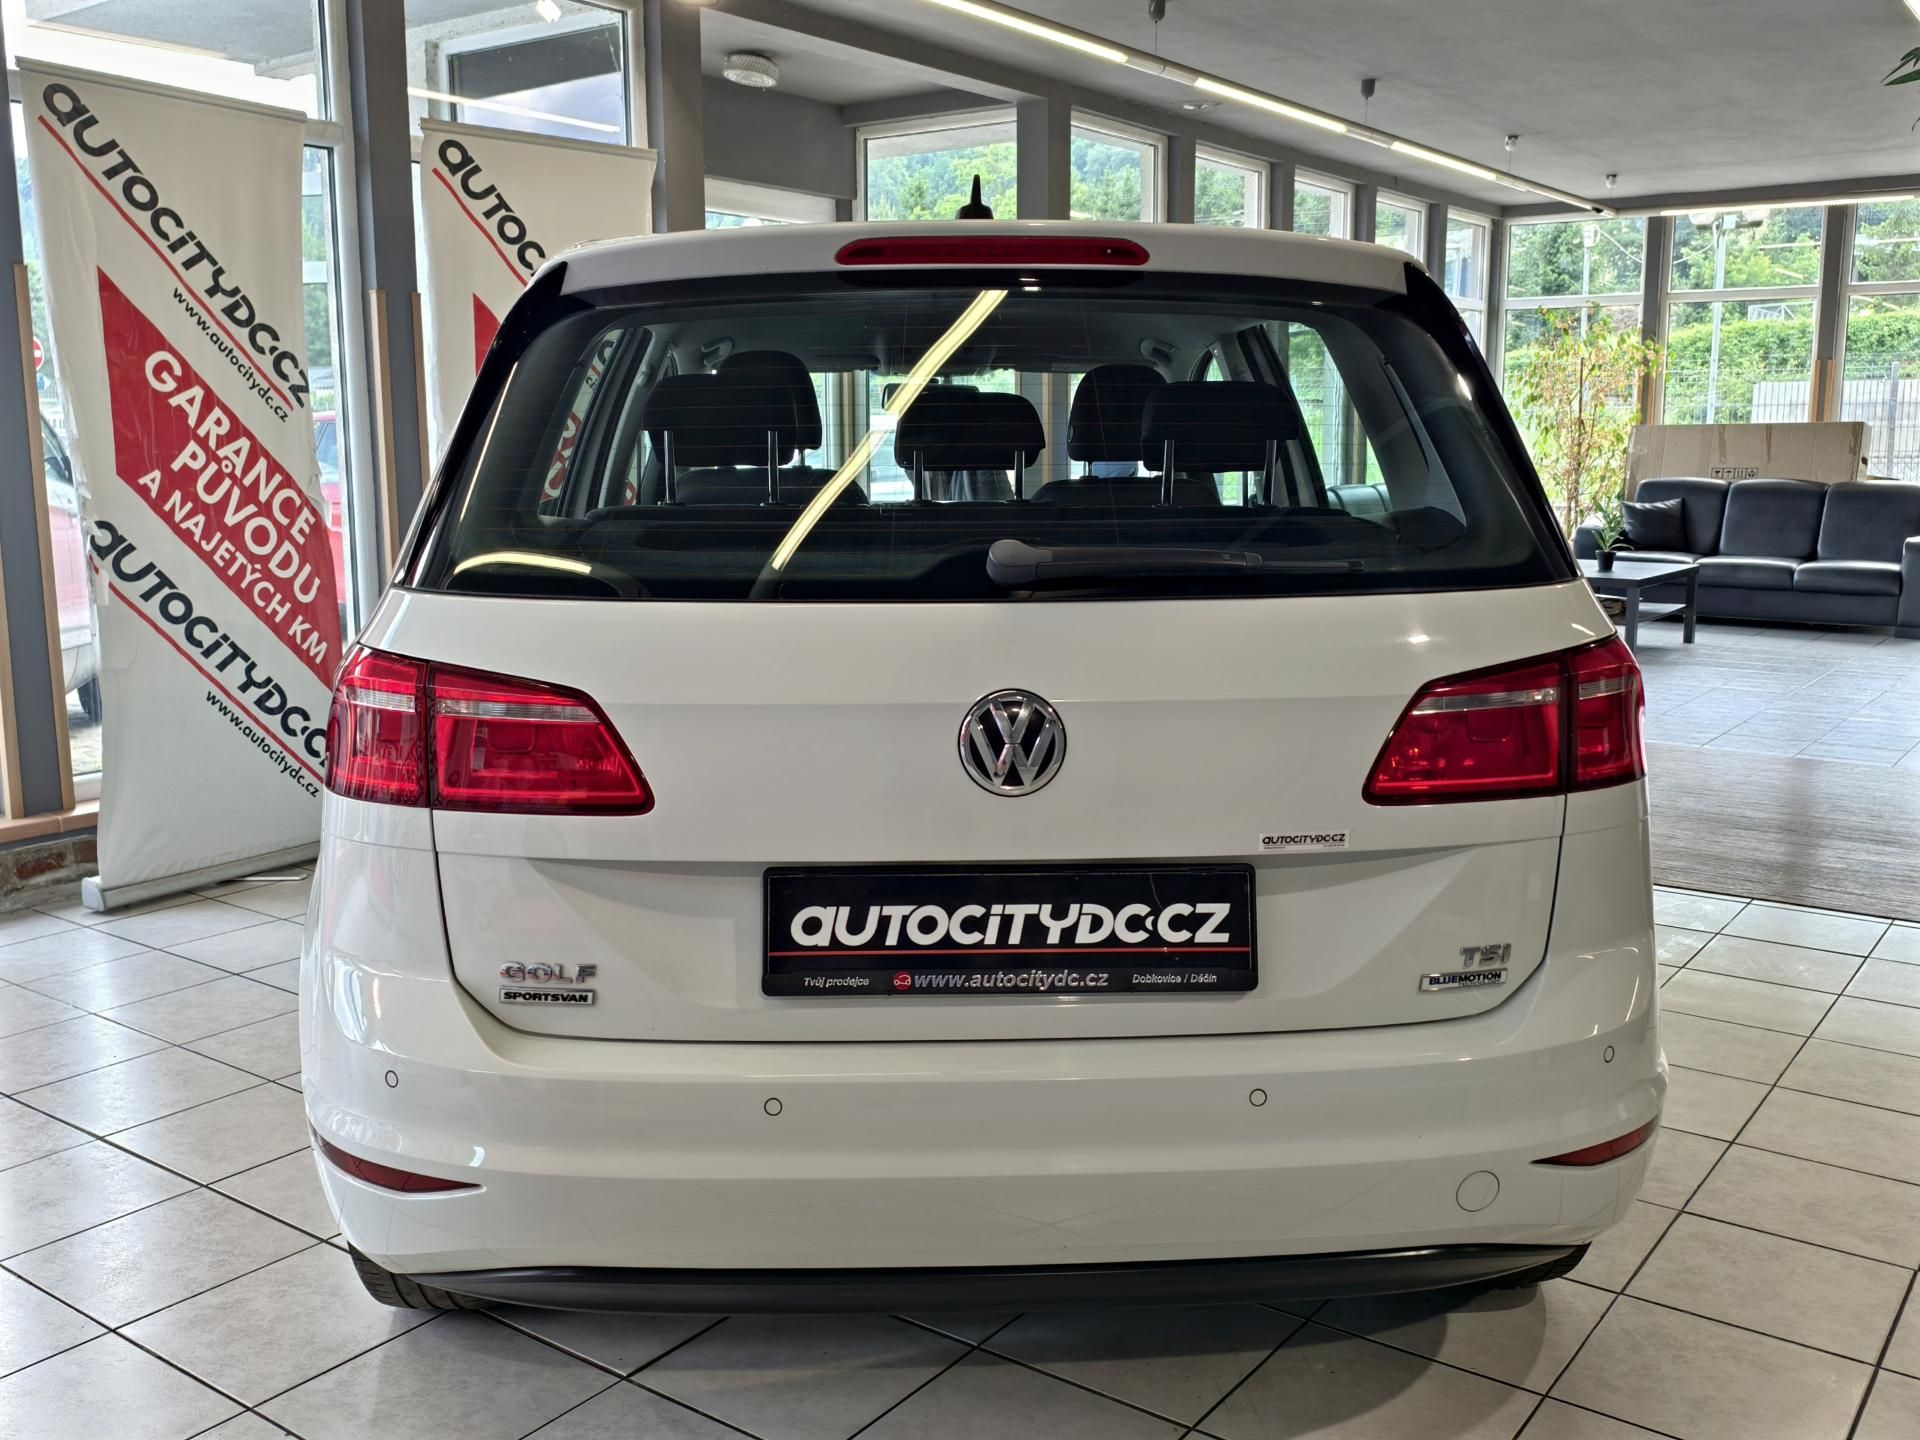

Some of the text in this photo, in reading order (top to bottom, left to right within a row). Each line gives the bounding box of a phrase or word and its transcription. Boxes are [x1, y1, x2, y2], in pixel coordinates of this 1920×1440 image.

[173, 287, 289, 423] www.autocitydc.cz
[144, 350, 316, 546] GARANCE
[170, 440, 321, 604] PŮVODU
[138, 469, 328, 665] A NAJETÝCH KM
[205, 690, 320, 798] www.autocitydc.cz
[1460, 943, 1512, 968] TSI
[499, 961, 597, 985] GOLF
[825, 976, 870, 989] prodejce
[914, 969, 1110, 991] www.autocitydc.cz
[1429, 971, 1502, 986] BLUEMOTION
[503, 991, 589, 1003] SPORTSVAN
